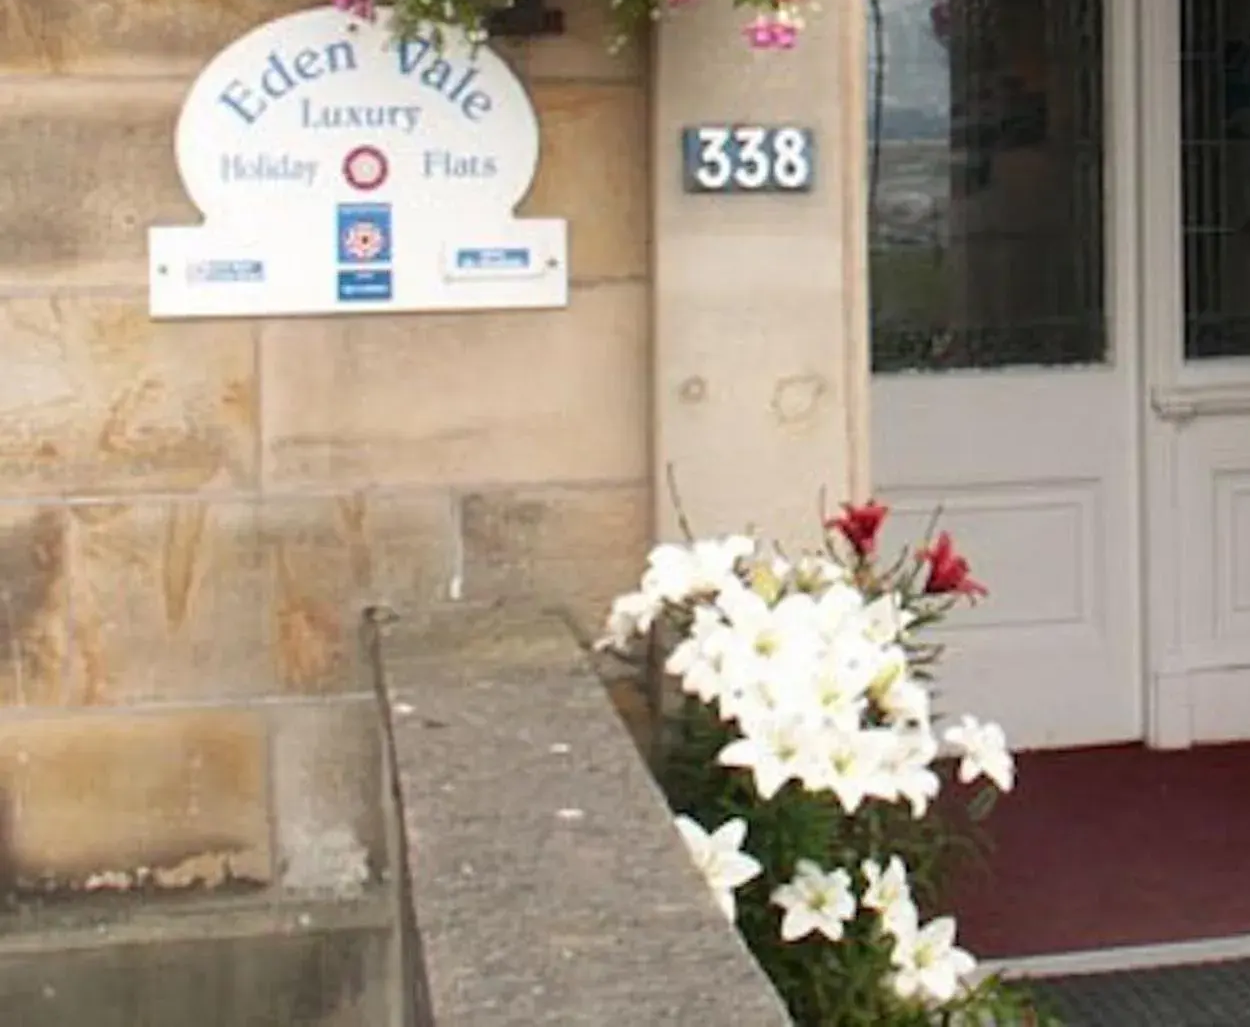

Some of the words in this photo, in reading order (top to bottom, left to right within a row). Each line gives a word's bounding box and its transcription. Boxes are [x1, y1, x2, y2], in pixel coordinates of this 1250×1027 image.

[219, 39, 357, 124] Eden
[391, 37, 492, 121] Vale
[301, 100, 421, 131] Luxury
[221, 153, 317, 184] Holiday
[423, 152, 497, 178] Flats
[695, 127, 809, 188] 338
